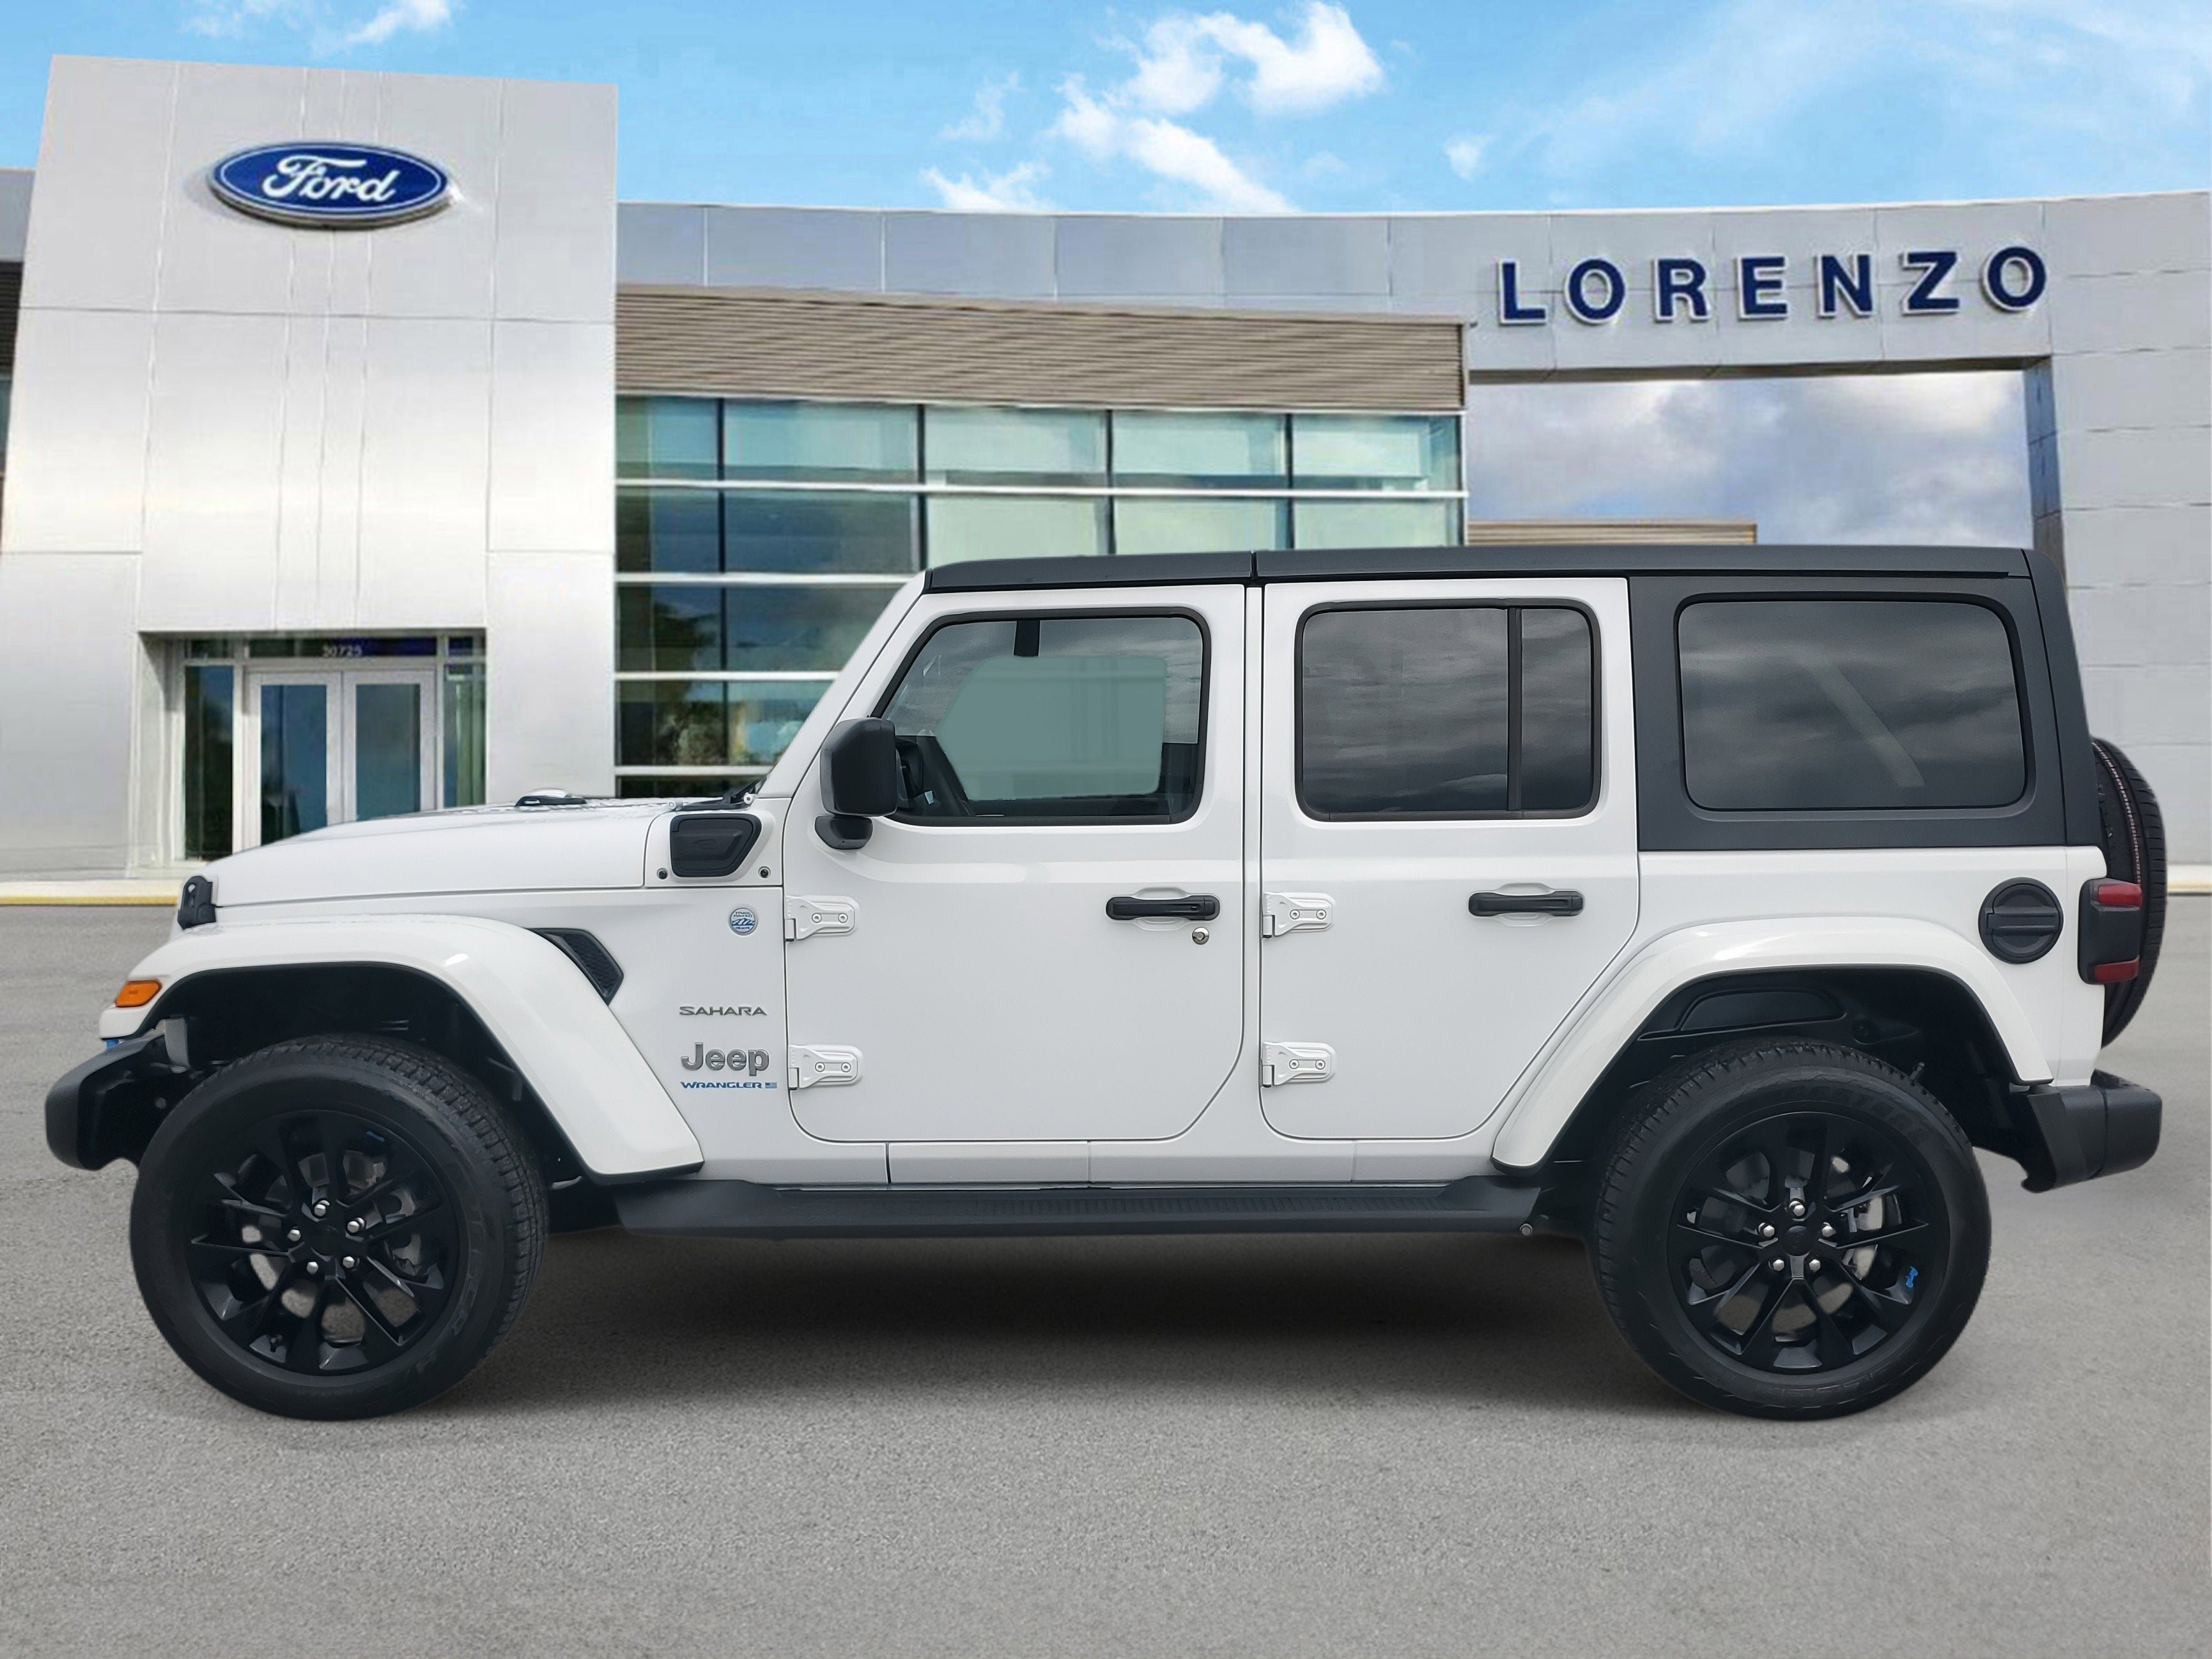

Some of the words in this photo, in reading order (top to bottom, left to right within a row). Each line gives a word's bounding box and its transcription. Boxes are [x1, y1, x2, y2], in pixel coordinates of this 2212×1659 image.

[262, 154, 399, 201] Ford
[1497, 245, 2047, 324] LORENZO
[679, 1006, 768, 1016] SAHARA
[681, 1042, 770, 1076] Jeep
[680, 1081, 762, 1089] WRANGLER
